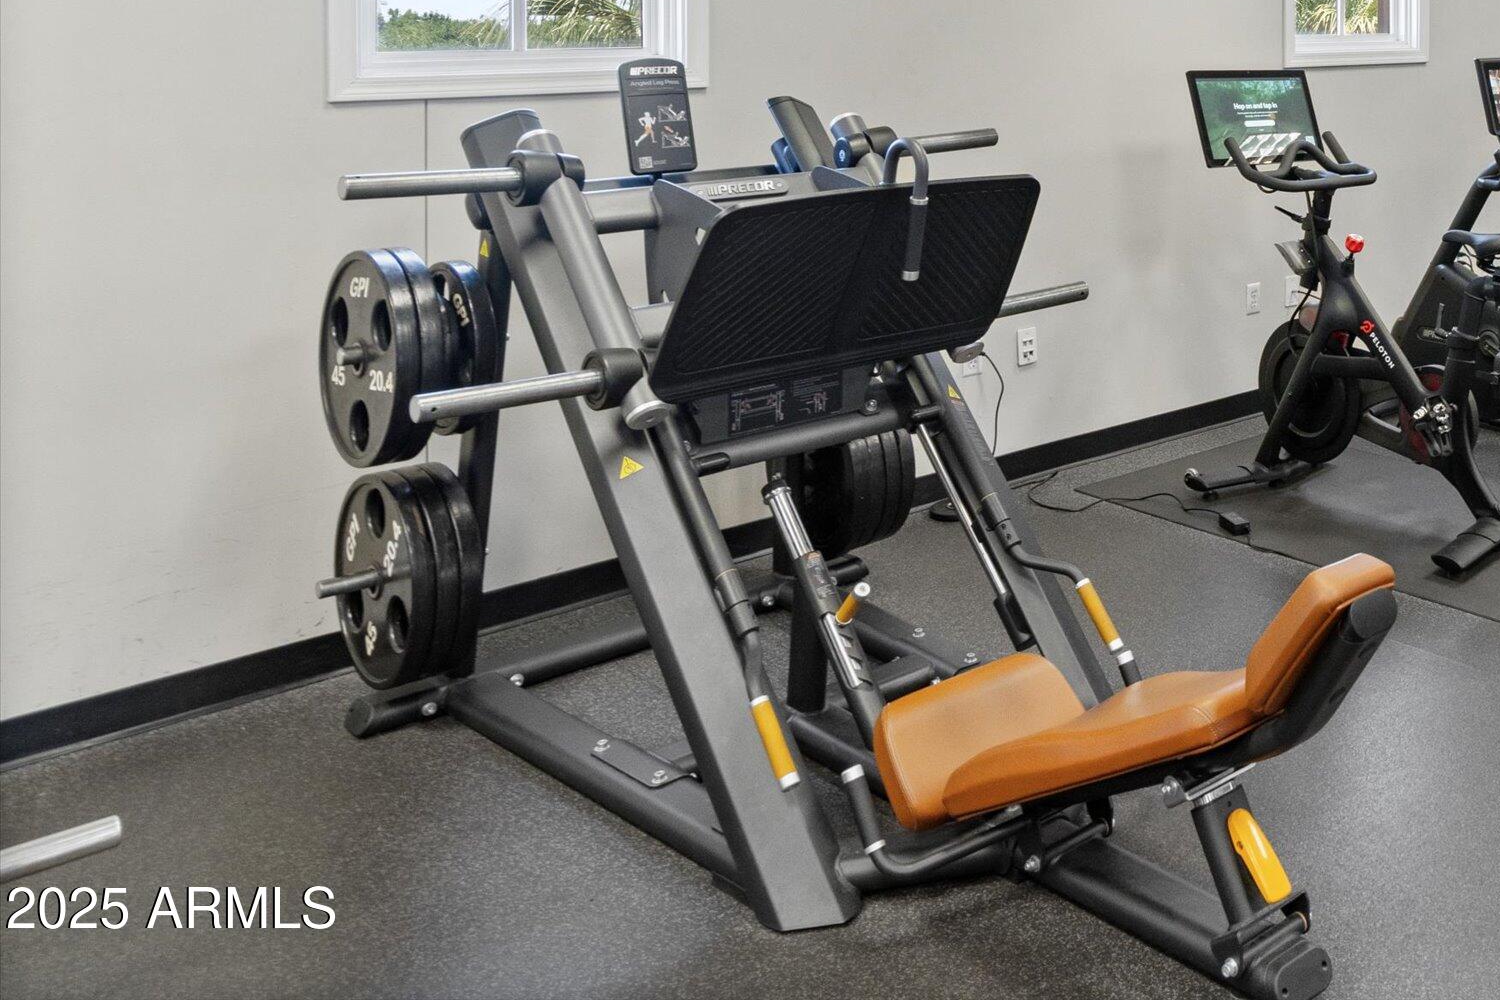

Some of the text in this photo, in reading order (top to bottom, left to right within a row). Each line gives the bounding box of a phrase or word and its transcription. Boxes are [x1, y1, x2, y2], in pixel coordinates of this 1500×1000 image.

[637, 66, 678, 76] PRECOR
[1233, 102, 1245, 111] Hop
[717, 180, 776, 196] PRECOR
[350, 277, 370, 298] GPI
[453, 293, 471, 327] GPI
[1369, 331, 1395, 369] PELOTON
[331, 364, 346, 386] 45
[369, 369, 393, 393] 20.4
[346, 512, 360, 562] GPI
[383, 520, 401, 577] 20.4
[364, 621, 377, 656] 45
